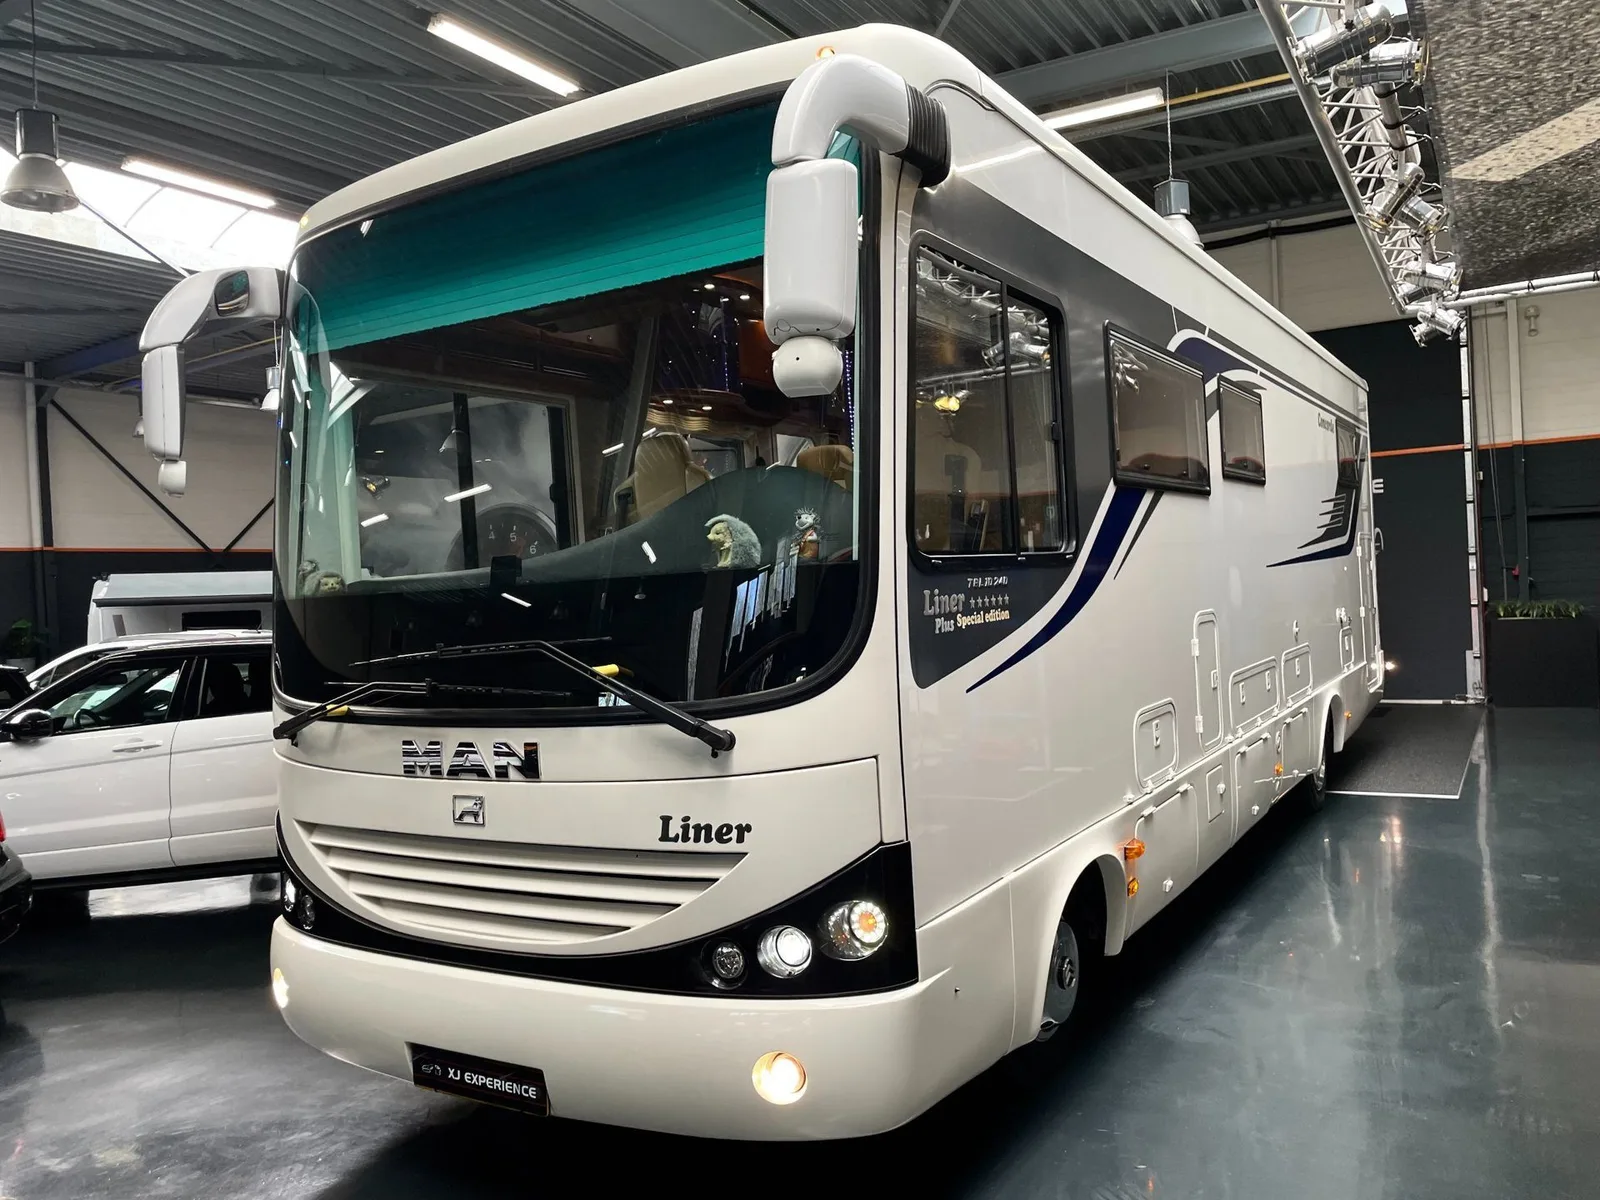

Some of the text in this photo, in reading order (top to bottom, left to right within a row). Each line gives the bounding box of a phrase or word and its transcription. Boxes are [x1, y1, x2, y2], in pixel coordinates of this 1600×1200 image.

[923, 588, 965, 615] Liner
[934, 617, 955, 634] Plus
[956, 608, 1010, 629] Special edition
[401, 740, 542, 780] MAN
[658, 815, 752, 844] Liner
[447, 1067, 537, 1099] XJ EXPERIENCE
